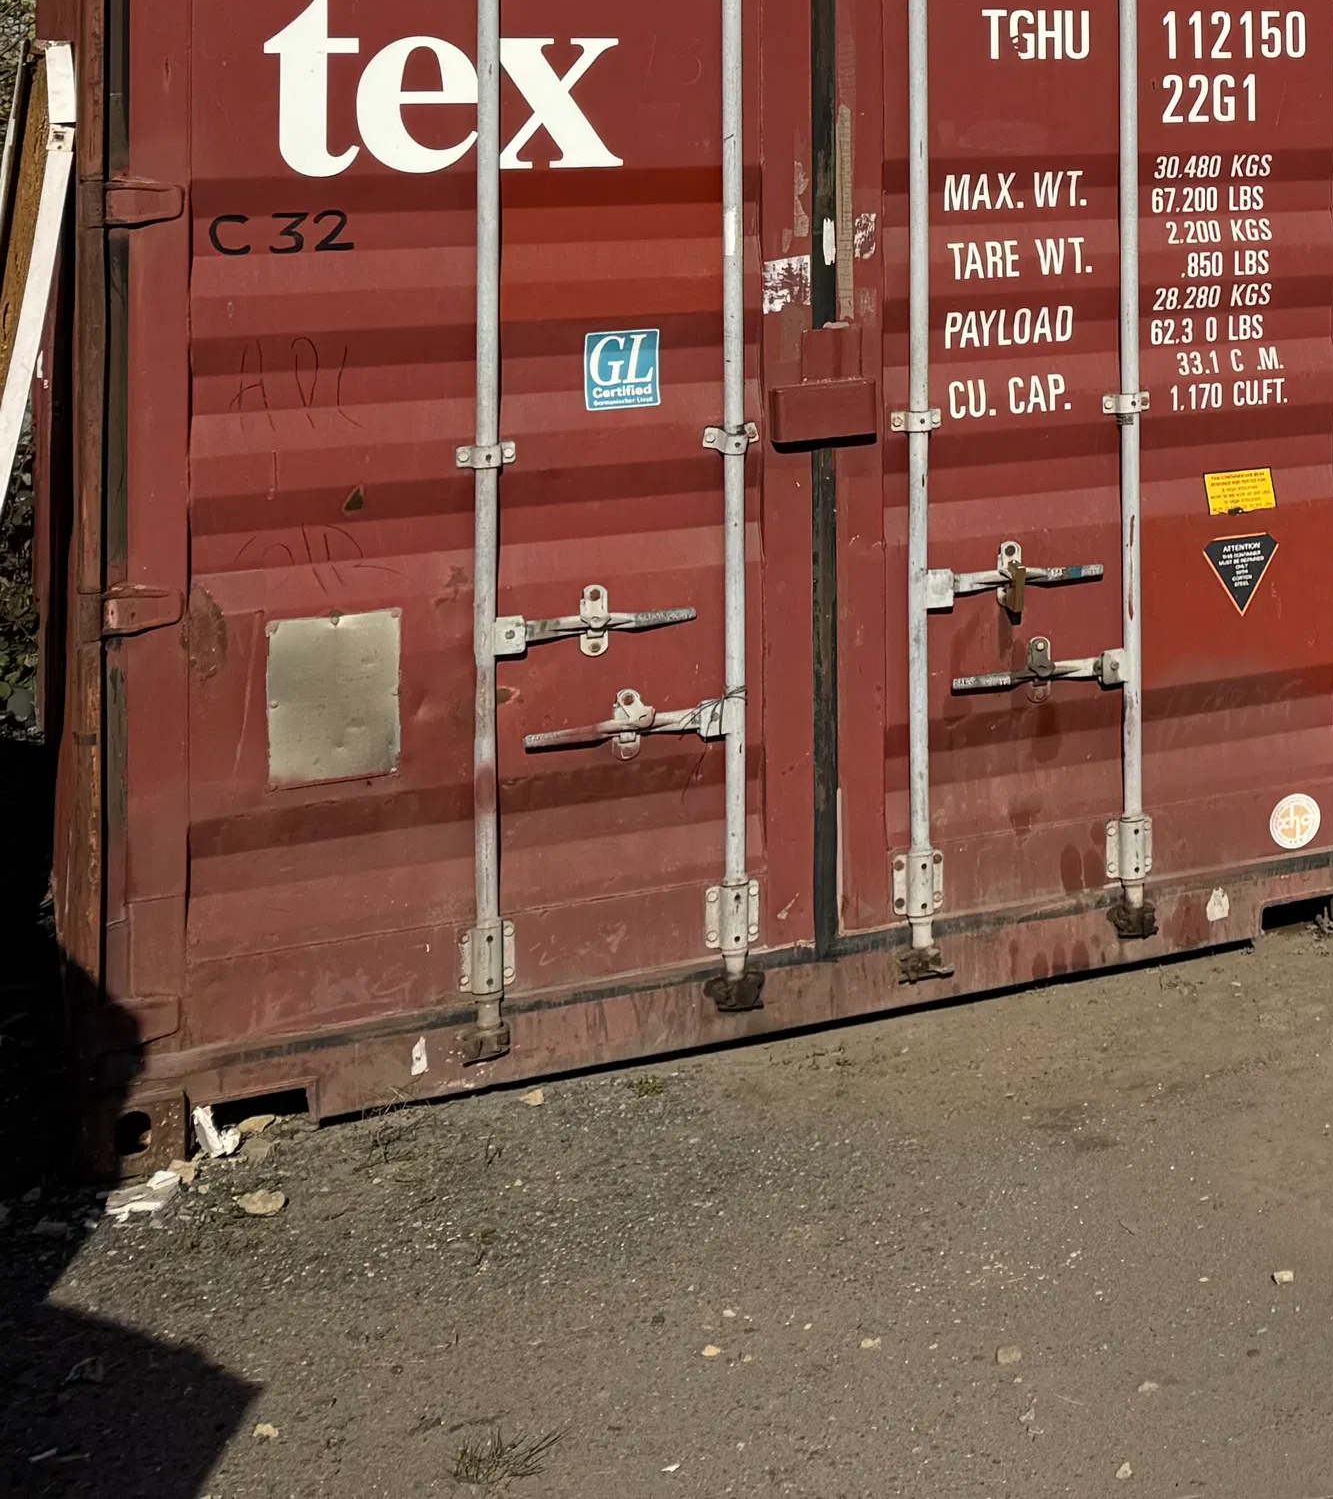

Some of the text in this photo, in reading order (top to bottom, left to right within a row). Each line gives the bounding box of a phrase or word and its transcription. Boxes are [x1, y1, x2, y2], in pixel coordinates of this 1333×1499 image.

[981, 8, 1091, 61] TGHU
[1161, 9, 1308, 60] 112150
[1161, 73, 1257, 124] 22G1
[1152, 153, 1273, 180] 30.480 KGS
[943, 169, 1088, 212] MAX. WT.
[1151, 186, 1265, 213] 67.200 LBS
[1165, 217, 1273, 246] 2.200 KGS
[947, 236, 1093, 281] TARE WT.
[1232, 250, 1270, 276] LBS
[1152, 282, 1273, 311] 28.280 KGS
[944, 305, 1075, 350] PAYLOAD
[1227, 315, 1264, 341] LBS
[589, 333, 654, 387] GL
[1175, 350, 1220, 377] 33.1
[592, 383, 652, 399] Certified
[948, 372, 1073, 420] CU. CAP.
[1169, 377, 1289, 412] 1.170 CU.FT.
[1222, 542, 1261, 553] ATTENTION
